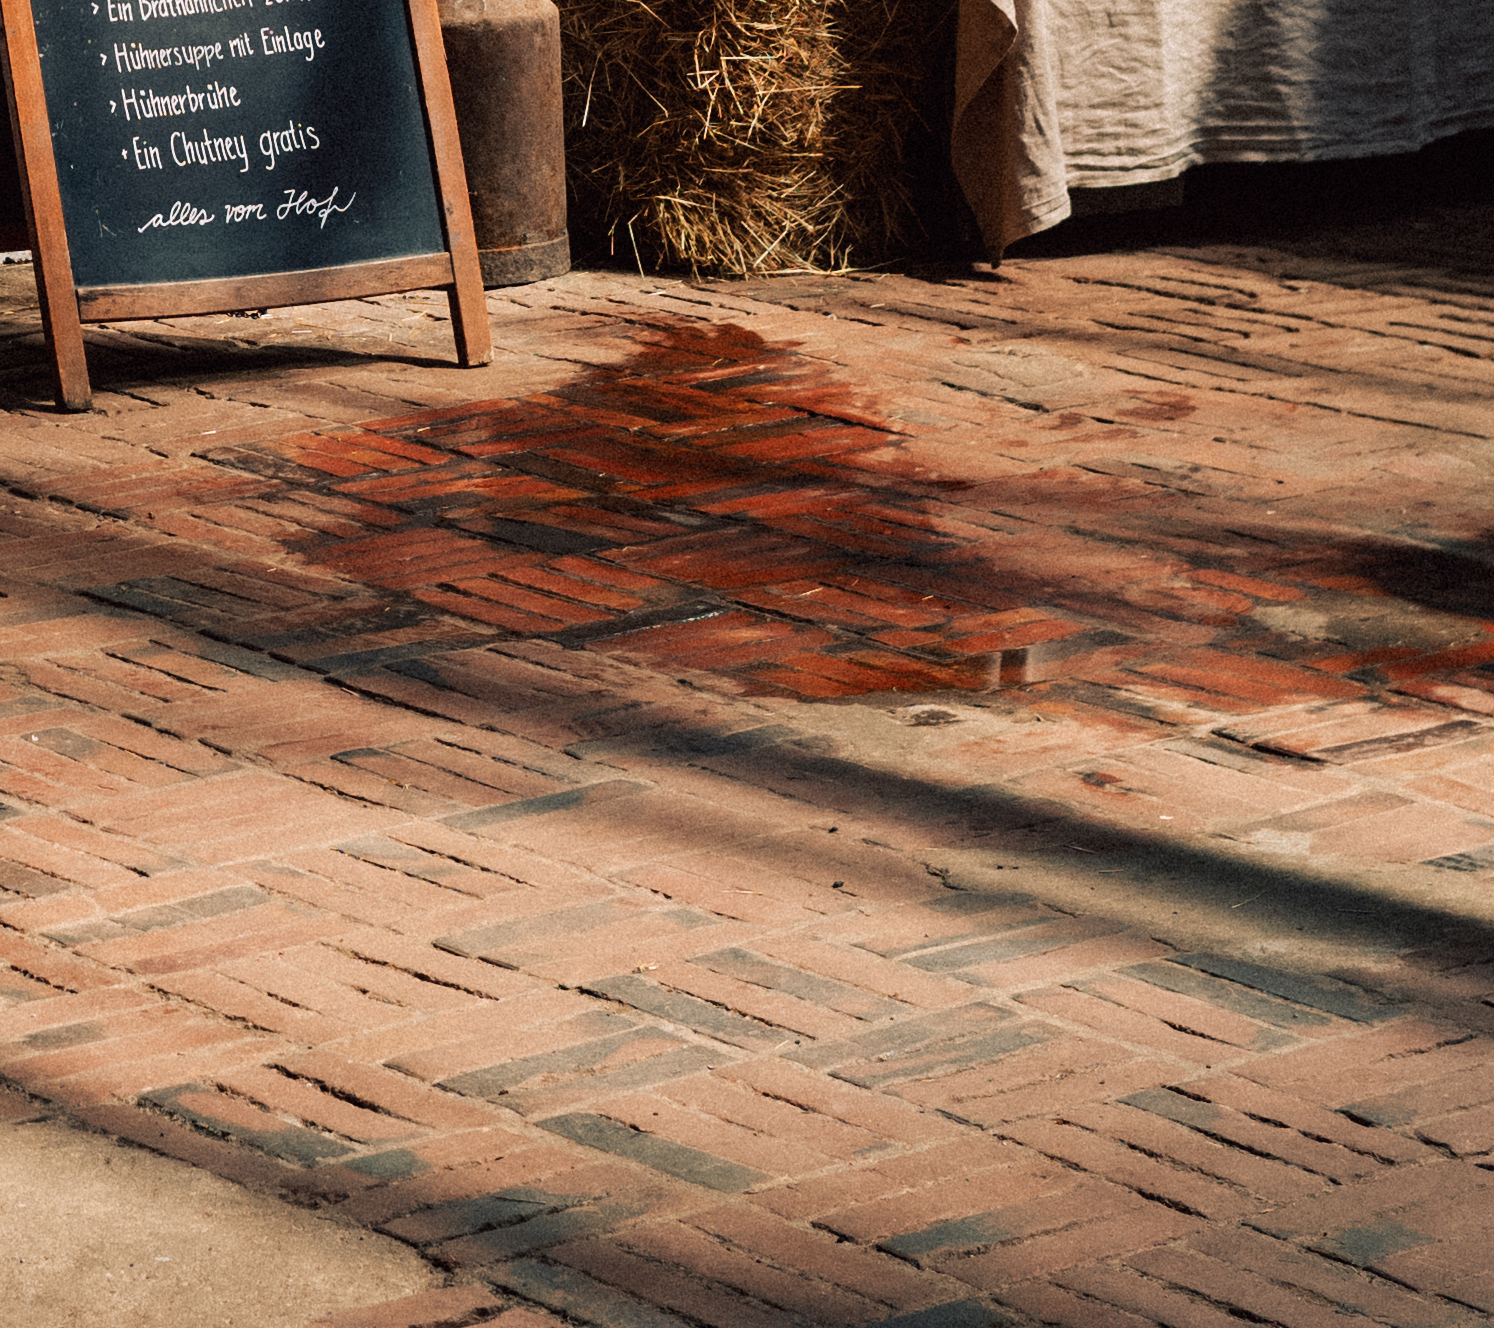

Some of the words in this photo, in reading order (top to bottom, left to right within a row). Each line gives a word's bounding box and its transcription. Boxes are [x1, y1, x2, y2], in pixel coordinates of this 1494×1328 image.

[114, 42, 223, 72] Hühnersuppe
[229, 33, 254, 57] mit
[261, 26, 325, 61] Einlage
[121, 81, 241, 121] Hühnerbrühe
[132, 137, 162, 169] Ein
[170, 129, 248, 172] Chutney
[259, 120, 320, 170] gratis
[138, 201, 214, 232] alles
[225, 203, 267, 223] vom
[277, 187, 356, 229] Hof
